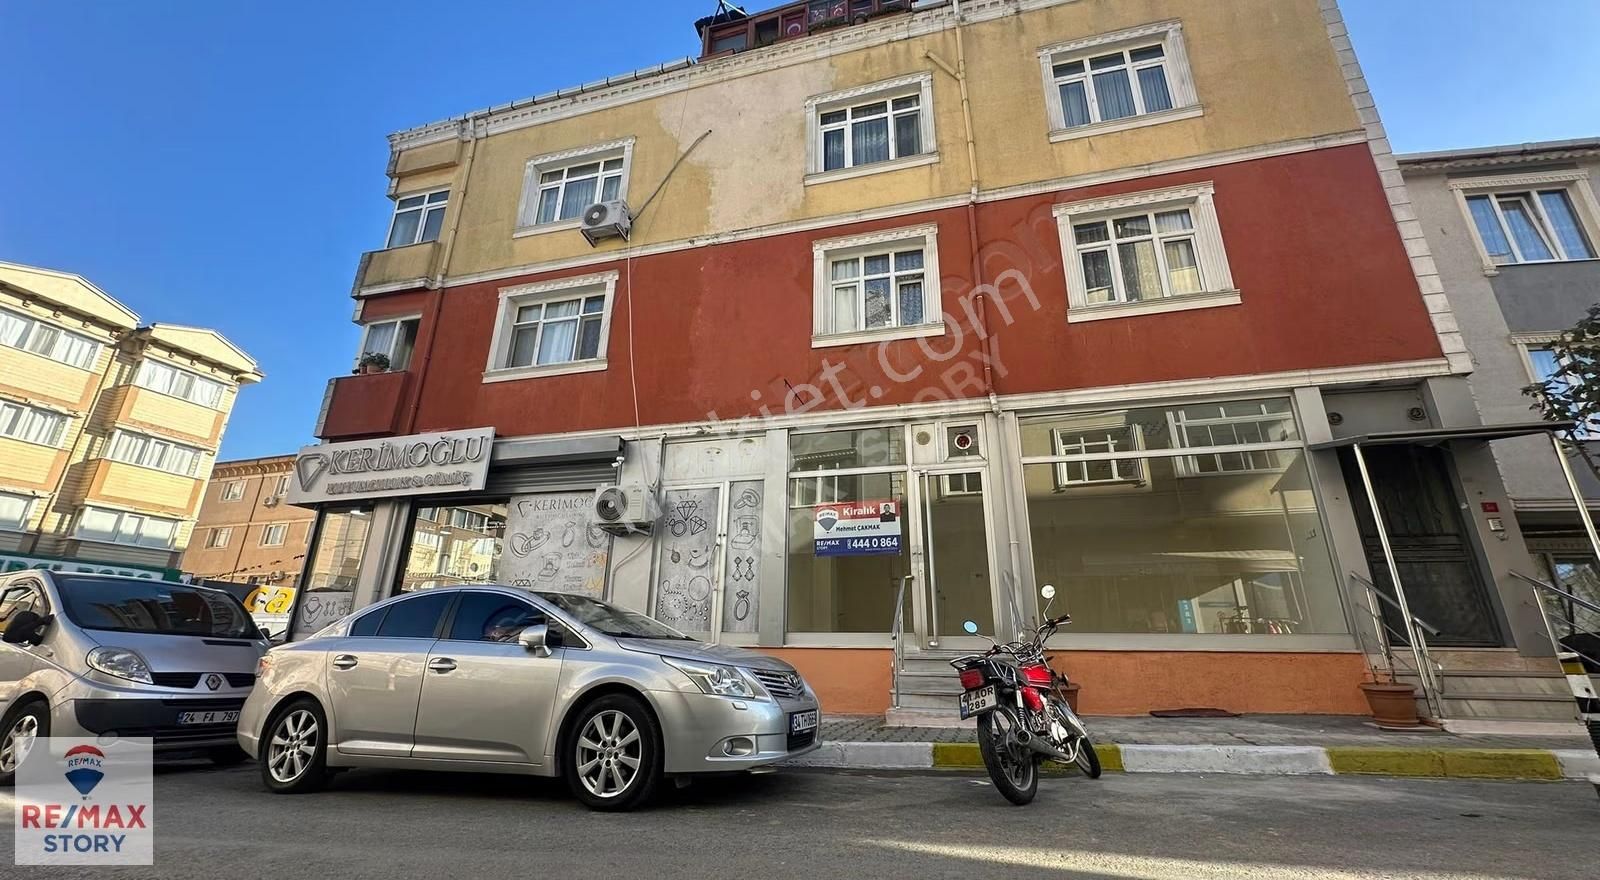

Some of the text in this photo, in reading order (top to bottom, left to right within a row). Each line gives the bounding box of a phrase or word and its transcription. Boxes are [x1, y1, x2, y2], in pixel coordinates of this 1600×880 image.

[329, 436, 485, 474] KERİMOĞLU
[843, 506, 876, 516] Kiralık
[857, 524, 881, 532] ÇAKMAK
[852, 538, 870, 548] 444
[872, 538, 878, 548] 0
[880, 537, 898, 547] 864
[974, 687, 994, 699] AOR
[969, 699, 986, 711] 289
[183, 711, 239, 723] 24 FA 797
